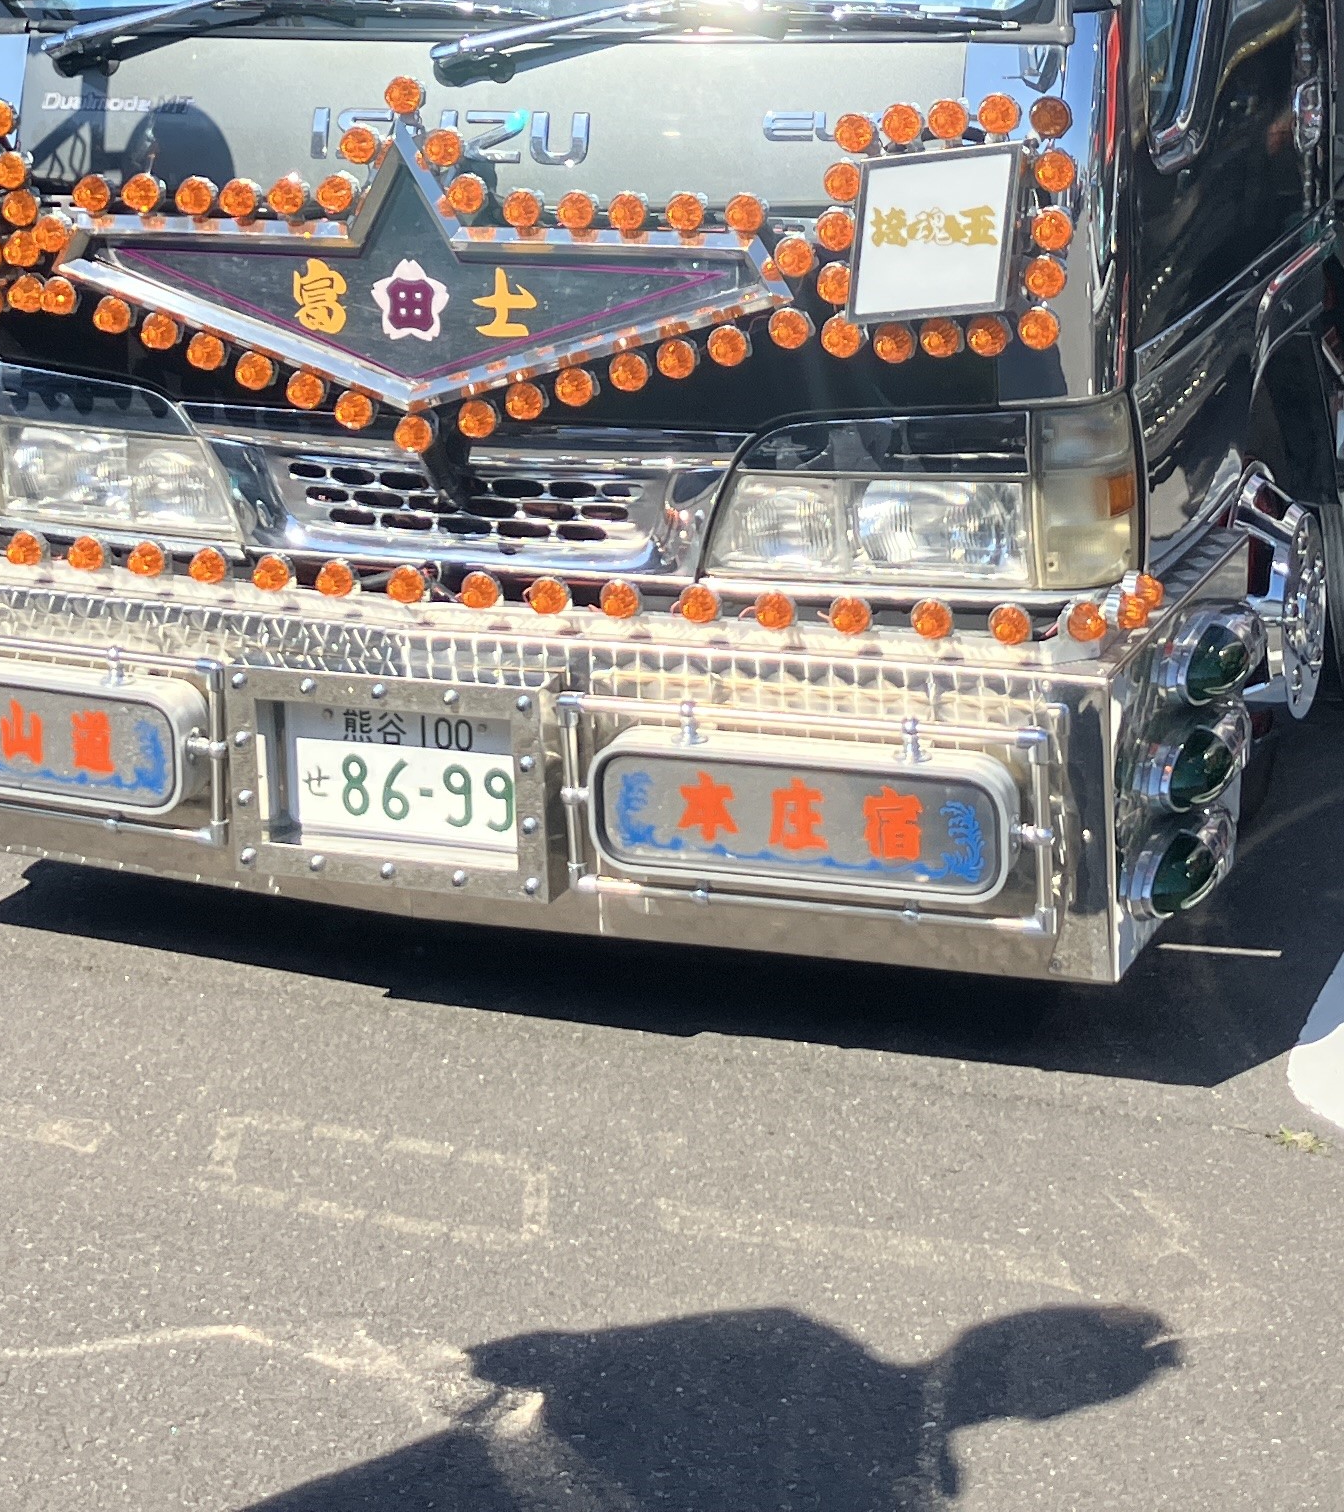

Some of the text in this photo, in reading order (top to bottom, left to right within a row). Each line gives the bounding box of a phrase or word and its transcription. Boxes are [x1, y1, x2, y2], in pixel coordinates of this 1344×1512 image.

[41, 91, 152, 112] Dualmode
[342, 707, 474, 752] 熊谷 100
[301, 752, 515, 833] せ 86-99
[677, 771, 924, 862] 本庄宿
